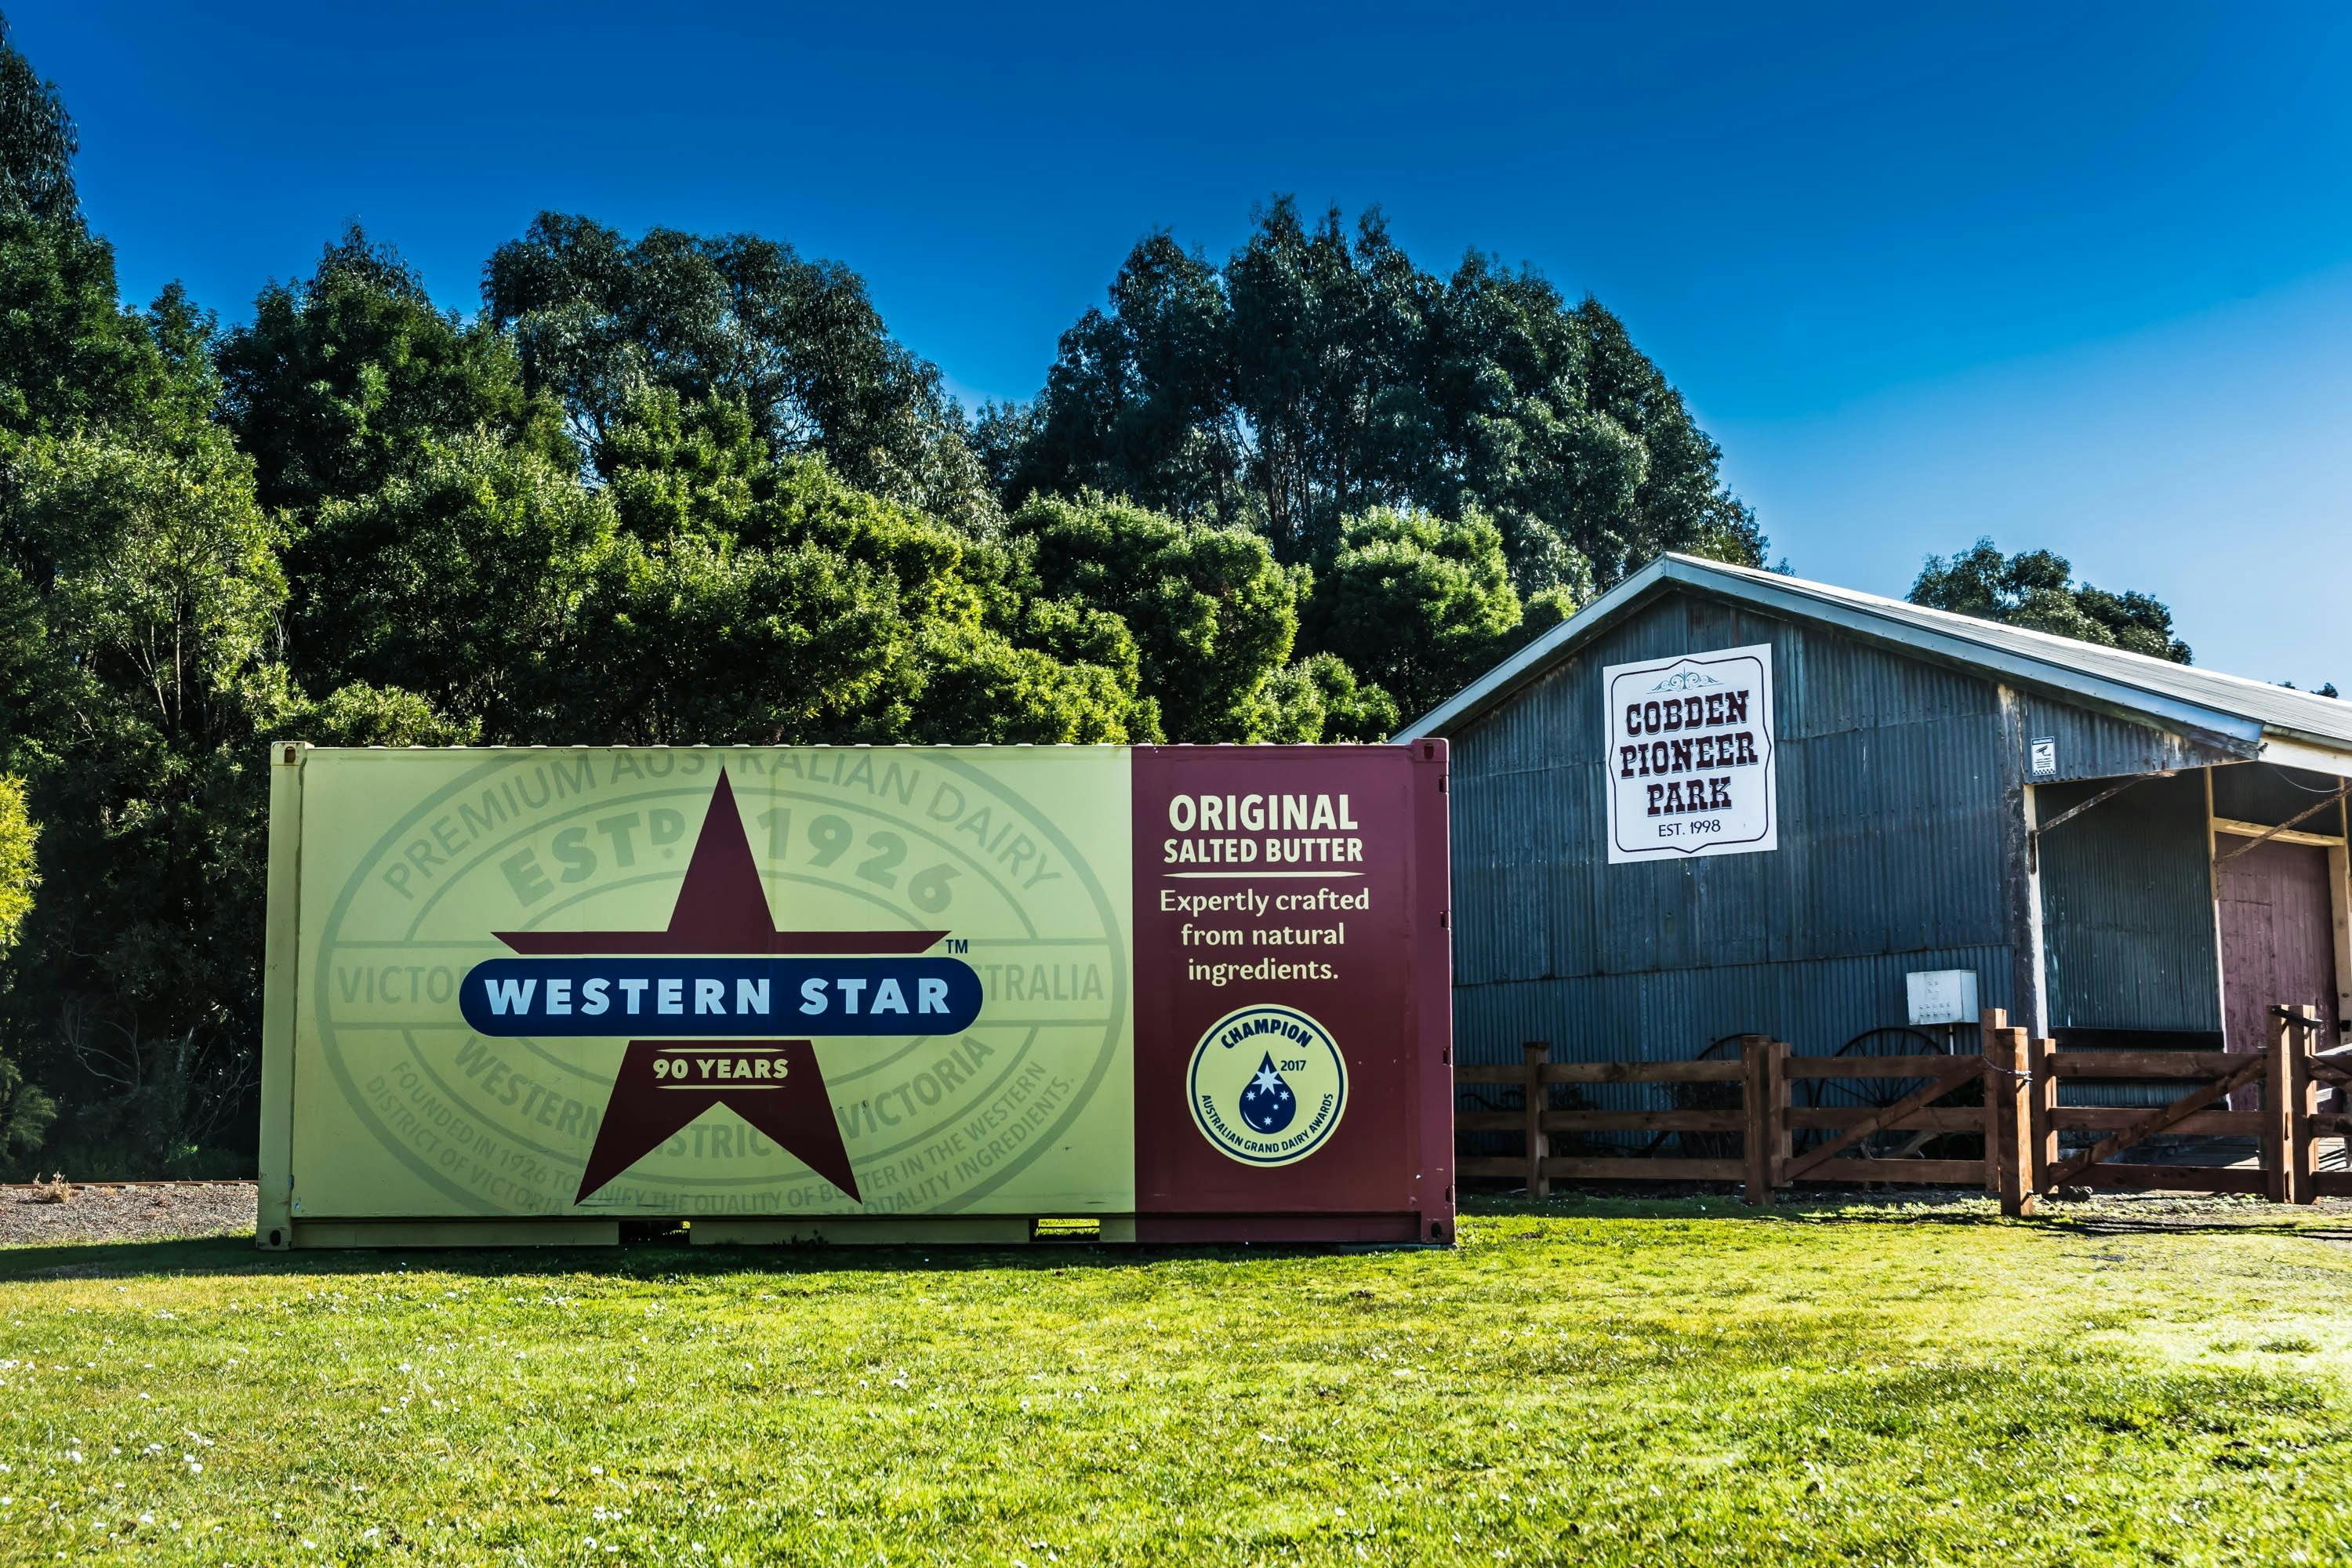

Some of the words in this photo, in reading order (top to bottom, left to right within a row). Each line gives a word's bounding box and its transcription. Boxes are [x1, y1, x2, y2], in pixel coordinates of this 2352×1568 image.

[1625, 690, 1749, 737] COBDEN
[1620, 731, 1759, 779] PIONEER
[1168, 793, 1358, 832] ORIGINAL
[1647, 776, 1732, 817] PARK
[382, 753, 597, 900] PREMIUM
[926, 782, 1063, 891] DAIRY
[1659, 823, 1686, 837] EST.
[1690, 819, 1721, 834] 1998
[756, 808, 963, 914] 1926
[1163, 838, 1258, 863] SALTED
[1265, 837, 1363, 863] BUTTER
[1160, 887, 1269, 917] Expertly
[1276, 887, 1370, 910] crafted
[946, 939, 968, 954] TM
[1181, 924, 1244, 946] from
[1252, 922, 1345, 946] natural
[338, 965, 474, 1004] VICTO
[975, 964, 1104, 1001] TRALIA
[1188, 958, 1338, 987] ingredients.
[485, 978, 770, 1015] WESTERN
[799, 978, 950, 1014] STAR
[1221, 1018, 1313, 1048] CHAMPION
[652, 1058, 688, 1080] 90
[696, 1058, 789, 1080] YEARS
[1280, 1060, 1307, 1071] 2017
[453, 1034, 599, 1140] WESTERN
[653, 1123, 786, 1159] STRIC
[837, 1035, 996, 1140] VICTORIA
[392, 1061, 474, 1144] FOUNDED
[472, 1135, 497, 1160] IN
[499, 1149, 547, 1184] 1926
[552, 1169, 578, 1193] TO
[590, 1185, 646, 1207] NIFY
[652, 1192, 692, 1212] THE
[695, 1191, 782, 1212] QUALITY
[787, 1184, 816, 1208] OF
[820, 1165, 900, 1203] BTER
[902, 1154, 926, 1179] IN
[924, 1133, 967, 1167] THE
[963, 1060, 1047, 1142] WESTERN
[1202, 1094, 1243, 1146] AUSTRALIAN
[1244, 1140, 1279, 1152] GRAND
[1282, 1130, 1309, 1151] DAIRY
[1310, 1093, 1334, 1134] AWARDS
[367, 1075, 441, 1154] DISTRICT
[440, 1148, 470, 1174] OF
[470, 1163, 564, 1214] VICTORIA
[954, 1076, 1074, 1183] INGREDIENTS.
